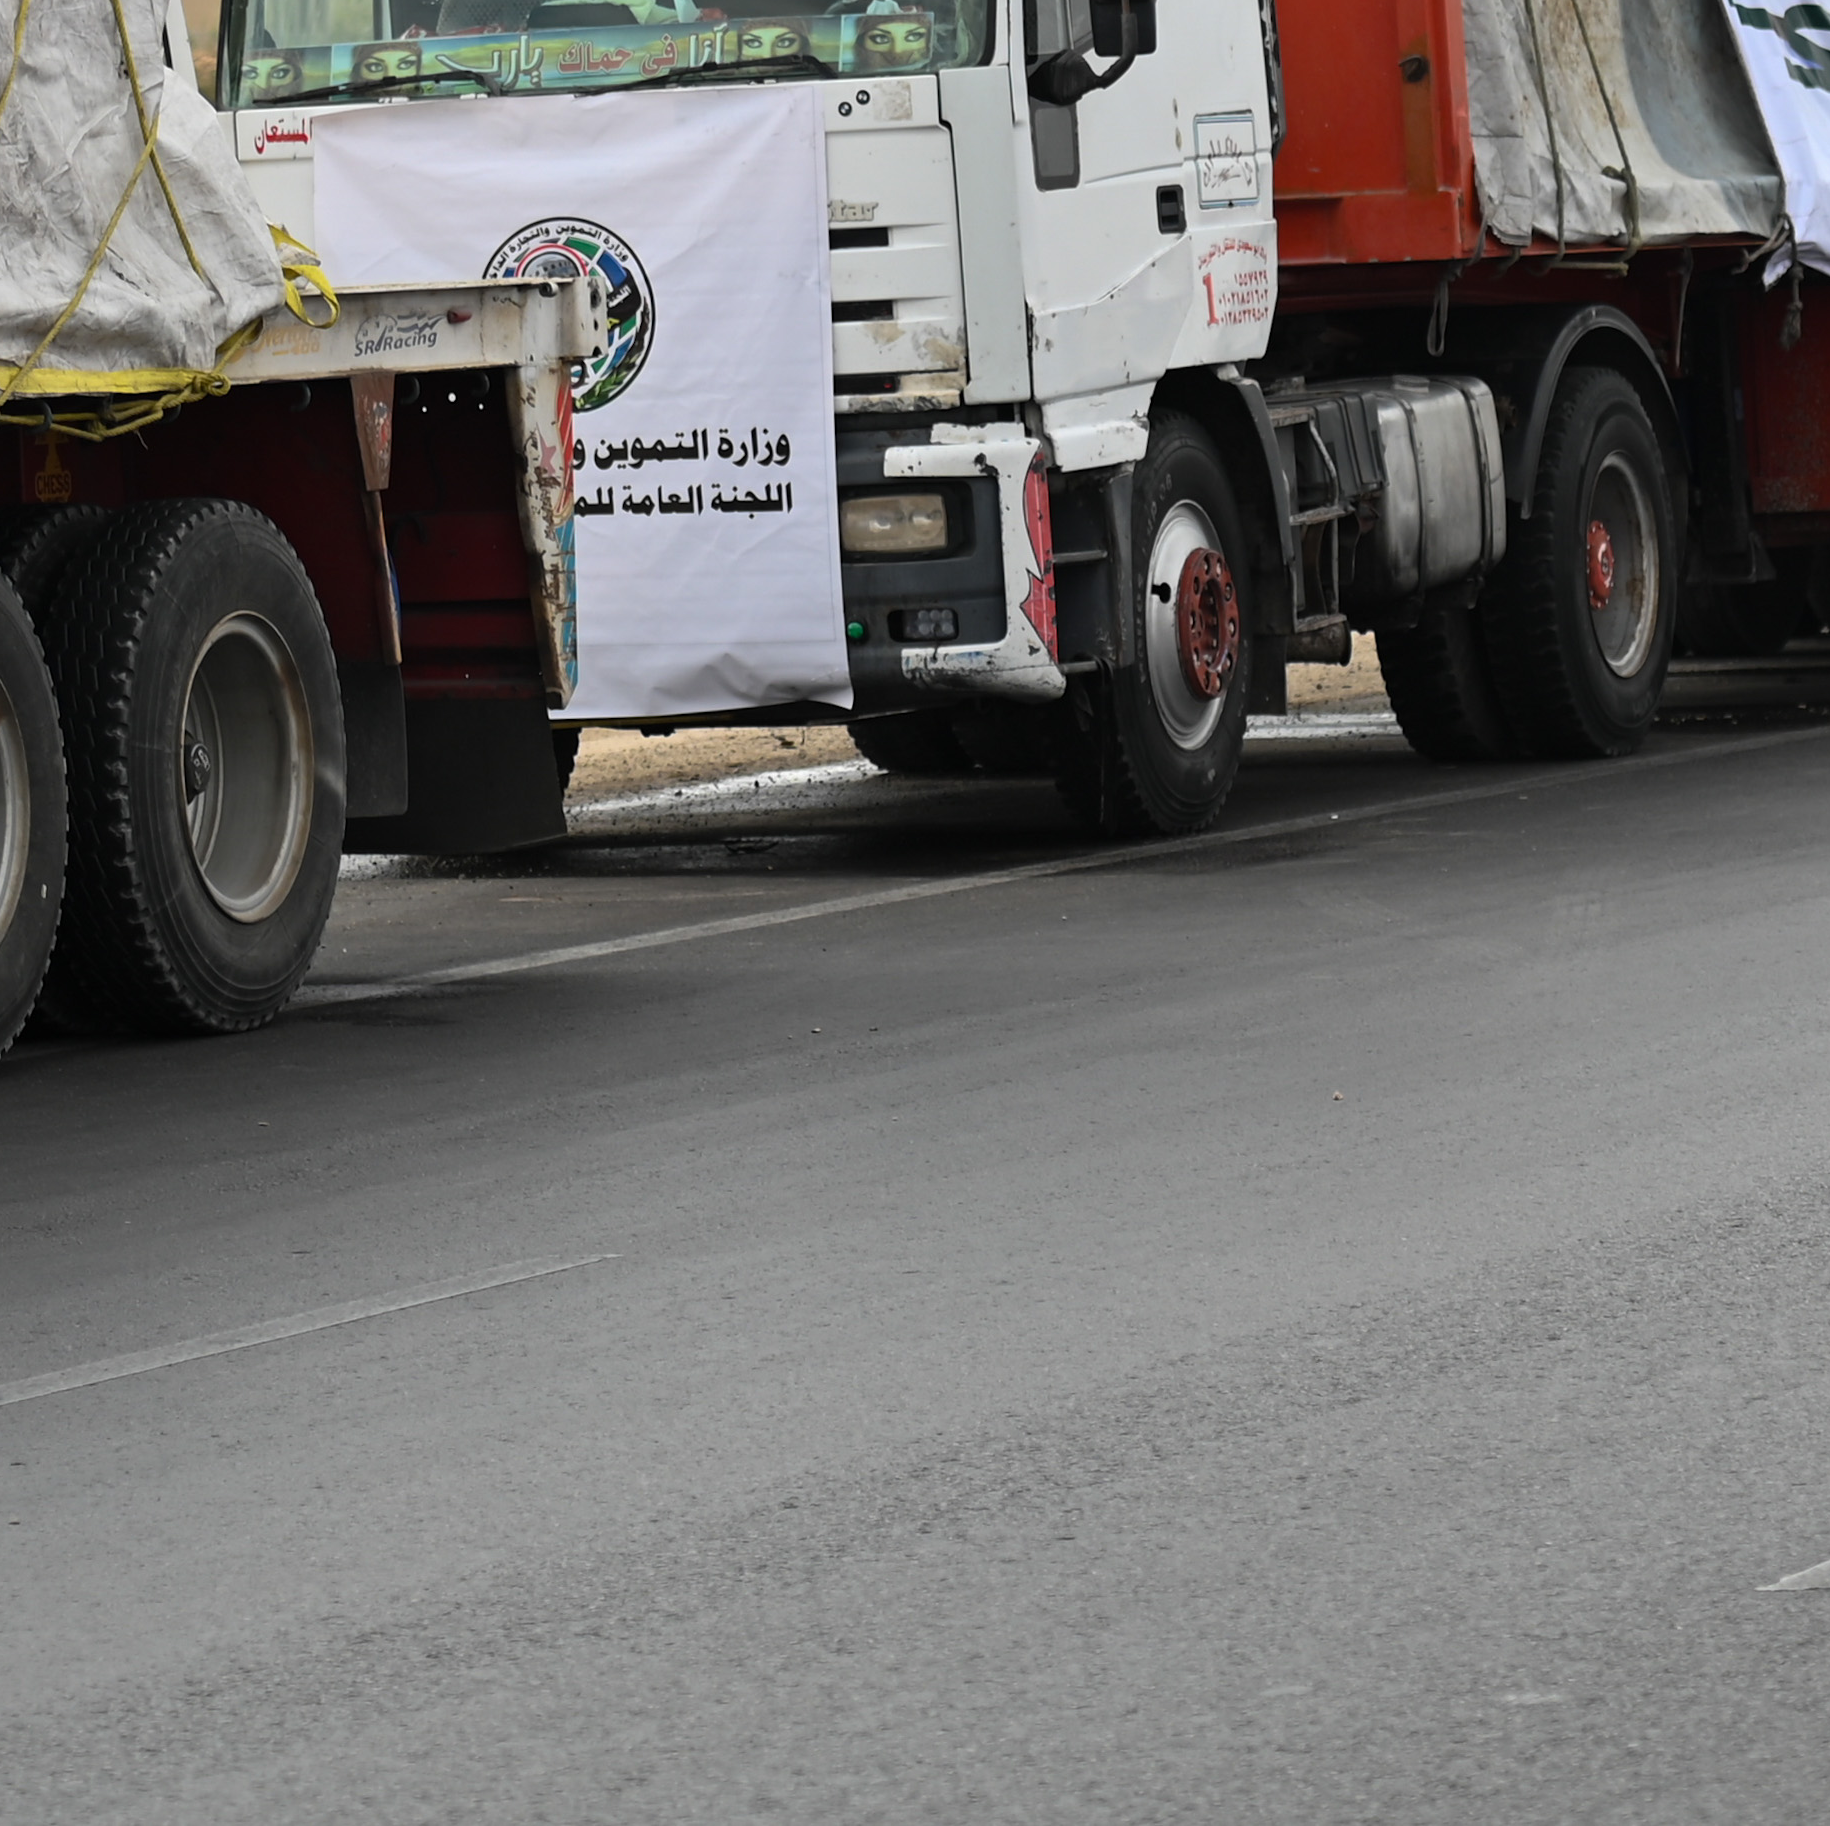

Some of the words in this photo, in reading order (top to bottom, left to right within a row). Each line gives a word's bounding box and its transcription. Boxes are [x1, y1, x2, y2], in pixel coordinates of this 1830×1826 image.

[593, 427, 709, 470] التموين
[716, 426, 792, 468] وزارة
[621, 483, 705, 517] العامة
[710, 481, 795, 520] اللجنة
